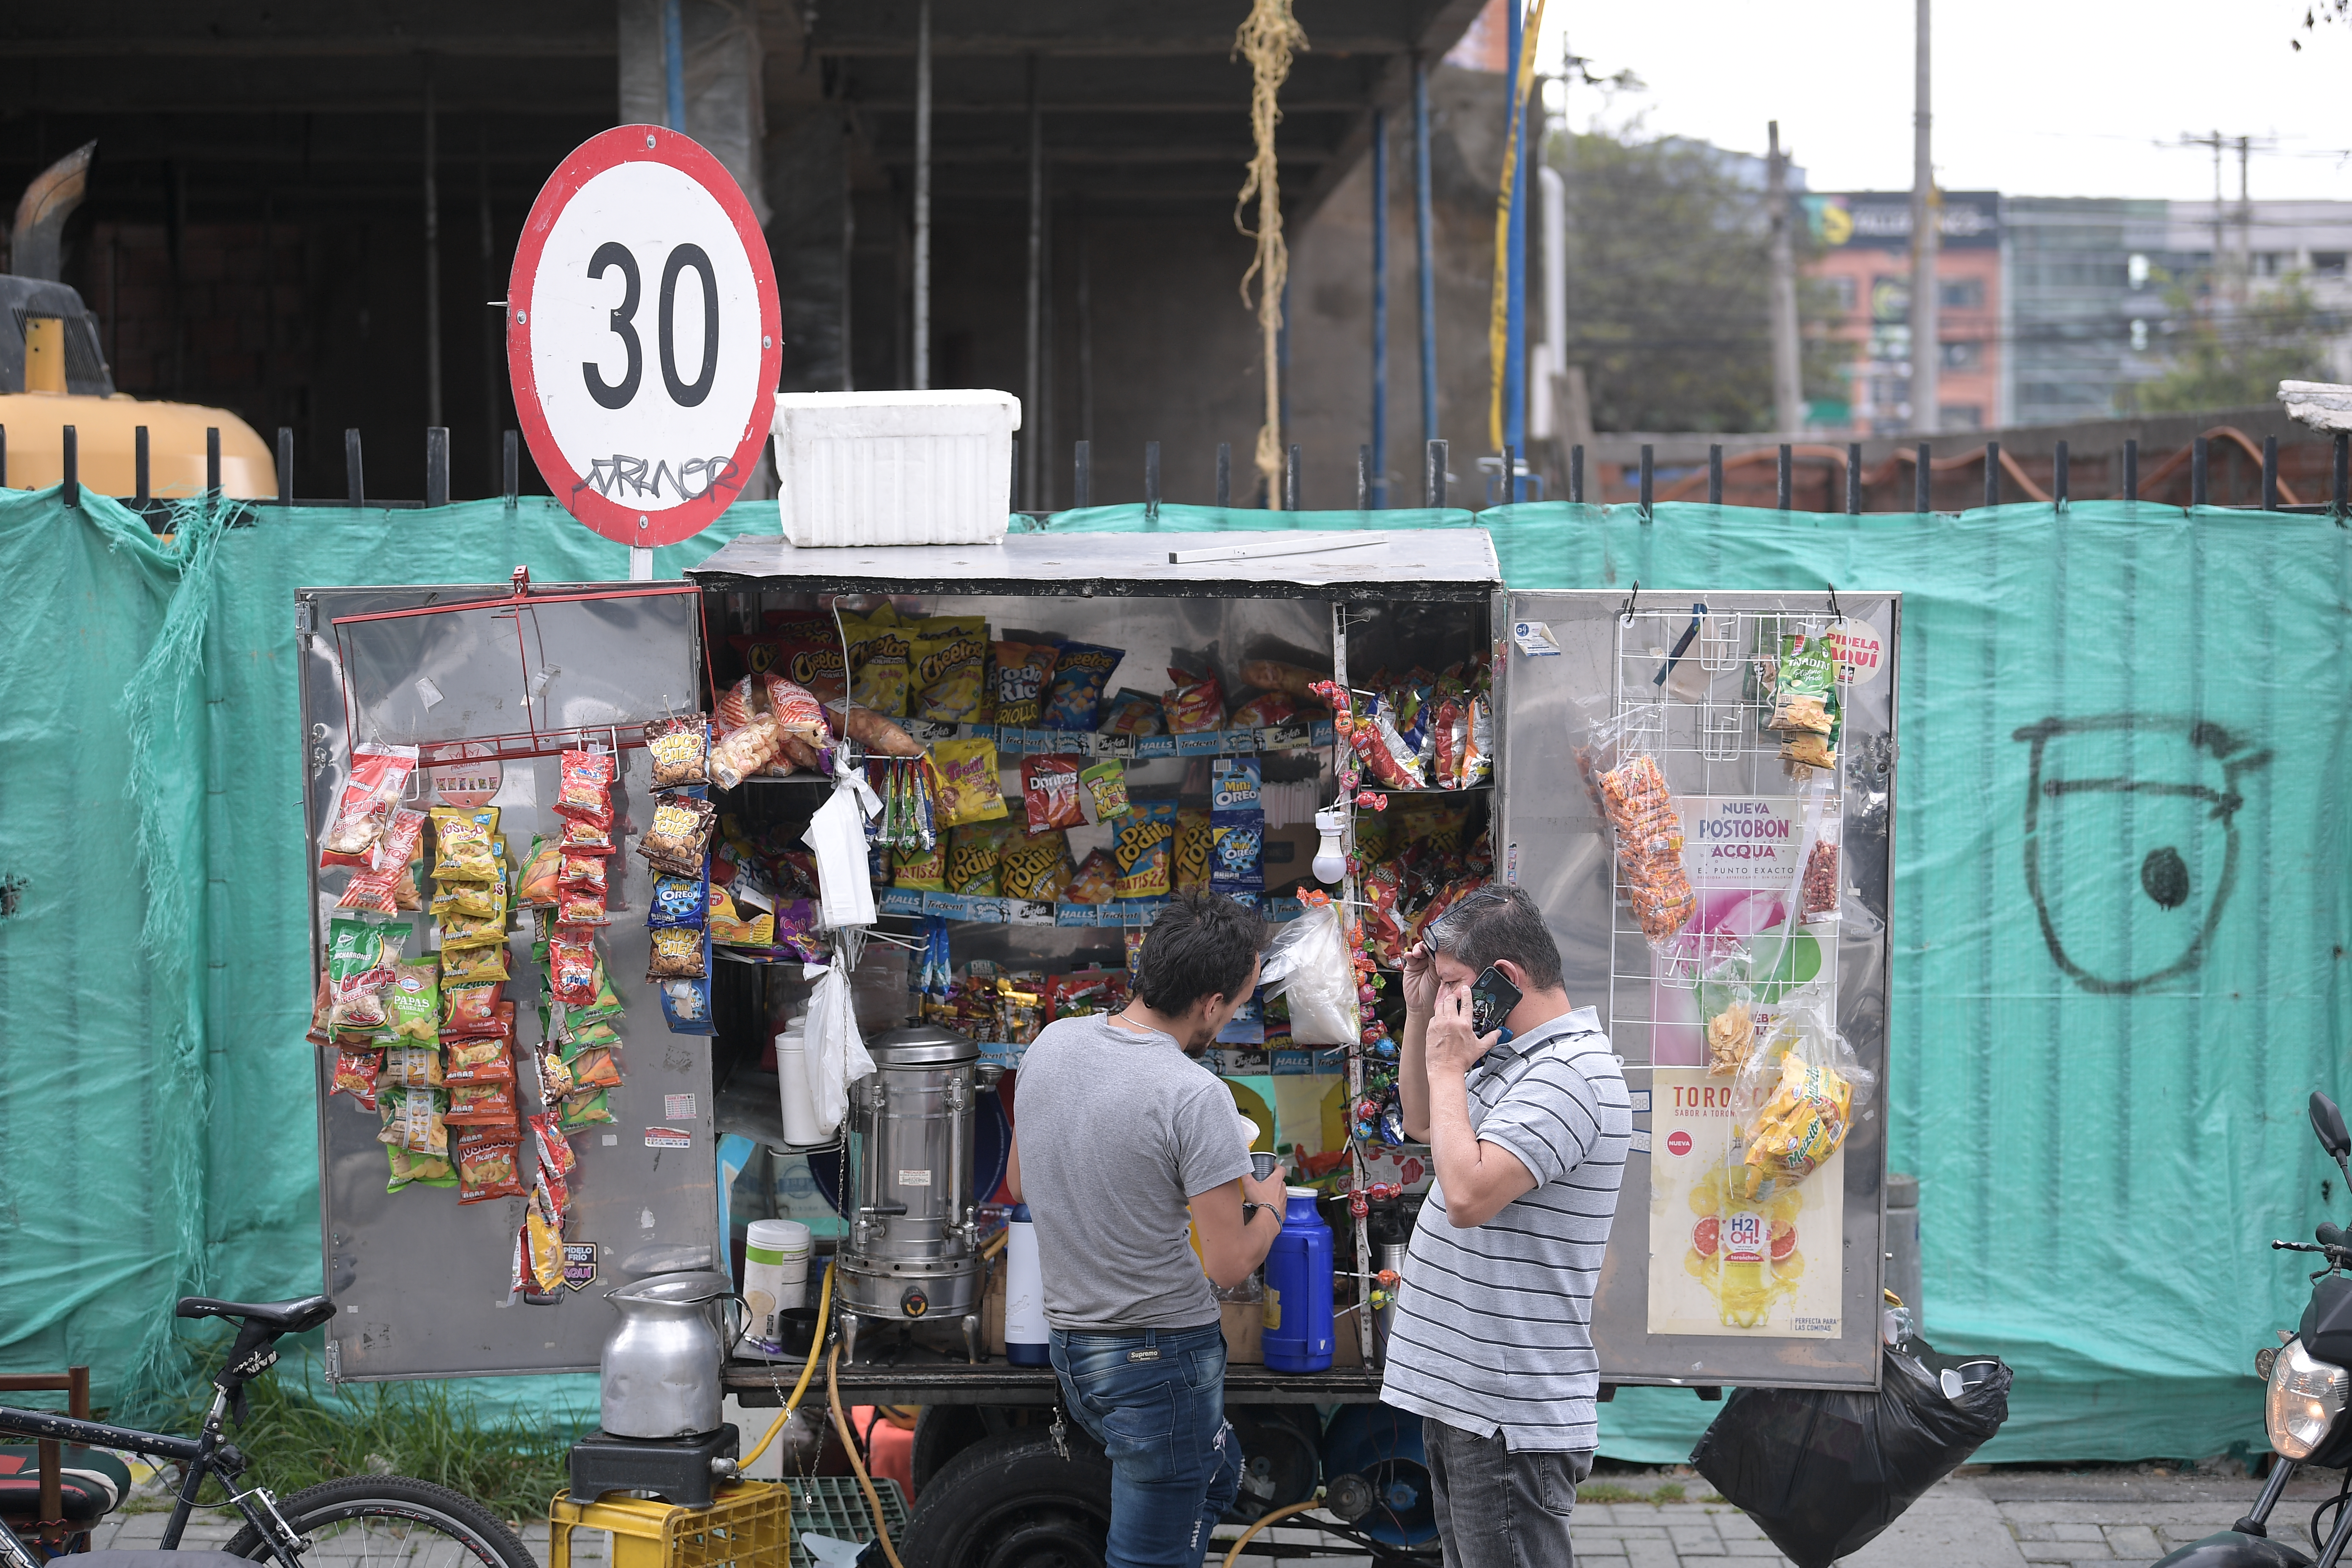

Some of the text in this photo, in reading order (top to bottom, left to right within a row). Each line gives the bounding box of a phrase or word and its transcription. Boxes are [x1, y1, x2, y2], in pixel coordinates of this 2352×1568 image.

[583, 242, 719, 409] 30
[1827, 633, 1880, 651] PIDELA
[848, 633, 909, 672] Cheetos
[1831, 647, 1878, 668] AQUÍ
[792, 650, 844, 684] Cheeto
[920, 639, 983, 683] Cheetos
[997, 664, 1043, 682] Todo
[998, 679, 1040, 703] Ric
[994, 703, 1038, 724] CRIOLLO
[1005, 736, 1041, 746] Trident
[1272, 728, 1301, 743] Chiclets
[650, 734, 702, 756] CHOCO
[1098, 739, 1126, 749] Chiclets
[1139, 741, 1173, 751] HALLS
[1181, 739, 1217, 749] Trident
[660, 747, 697, 765] CHEF
[946, 756, 985, 782] Trolli
[1029, 771, 1078, 791] Doritos
[1224, 781, 1251, 792] Mini
[1215, 792, 1257, 806] OREO
[1723, 803, 1770, 814] NUEVA
[653, 806, 699, 827] CHOCO
[655, 821, 691, 838] CHEF
[1119, 820, 1146, 843] De
[1700, 819, 1788, 838] POSTOBON
[1114, 819, 1173, 876] Todito
[1231, 841, 1250, 850] Mini
[1712, 845, 1775, 859] ACQUA
[1225, 849, 1255, 860] OREO
[1151, 869, 1167, 887] 22
[670, 883, 691, 892] Mini
[661, 890, 694, 901] OREO
[887, 895, 920, 905] HALLS
[927, 900, 964, 911] Trident
[1018, 905, 1048, 918] Chiclets
[1060, 910, 1094, 919] HALLS
[651, 929, 700, 944] CHOCO
[1368, 926, 1377, 934] BBQ
[659, 942, 694, 957] CHEF
[340, 962, 397, 995] Granja
[341, 989, 374, 1004] Picante
[394, 995, 430, 1008] PAPAS
[466, 992, 489, 1001] Tomate
[398, 1004, 425, 1013] CASERAS
[468, 1036, 491, 1047] Picante
[1233, 1055, 1261, 1068] Chiclets
[1276, 1058, 1309, 1066] HALLS
[475, 1151, 498, 1163] Picante
[1732, 1218, 1753, 1231] H2
[564, 1245, 592, 1255] PÍDELO
[568, 1252, 588, 1261] FRÍO
[564, 1266, 592, 1278] AQUÍ
